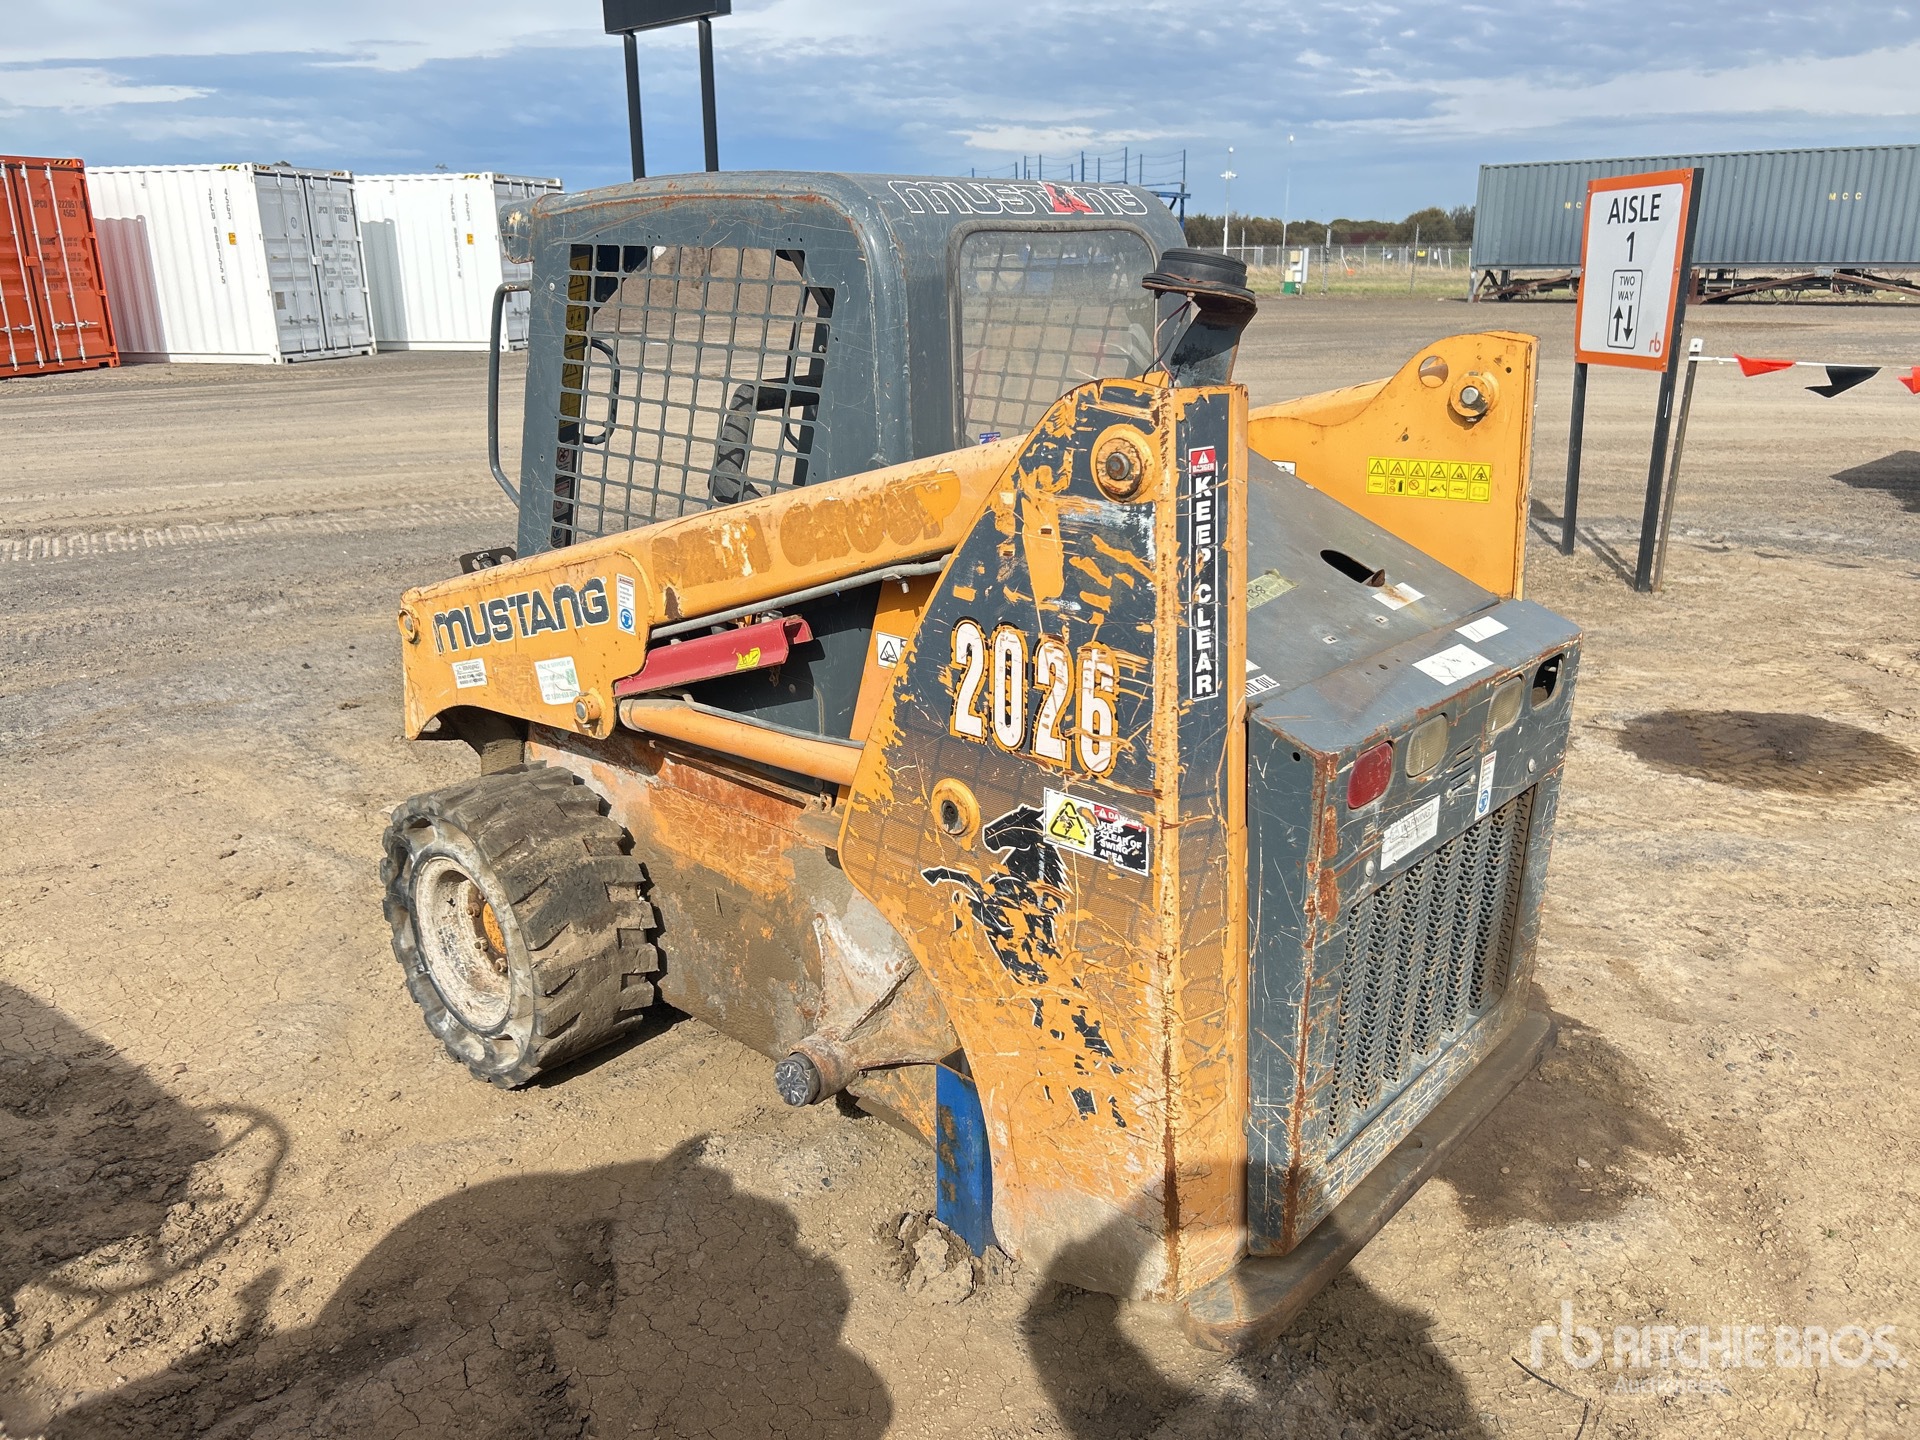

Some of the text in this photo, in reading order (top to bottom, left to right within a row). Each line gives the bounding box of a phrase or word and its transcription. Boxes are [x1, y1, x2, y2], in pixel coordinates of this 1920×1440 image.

[888, 180, 1147, 215] MUSTANG
[1607, 193, 1662, 225] AISLE
[1626, 231, 1636, 262] 1
[1618, 291, 1635, 301] WAY
[1619, 276, 1636, 286] TWO
[1649, 332, 1661, 353] rb
[1194, 475, 1213, 694] KEEP CLEAR
[432, 577, 610, 655] MUSTANG
[951, 618, 1119, 777] 2026
[1129, 840, 1143, 850] OF
